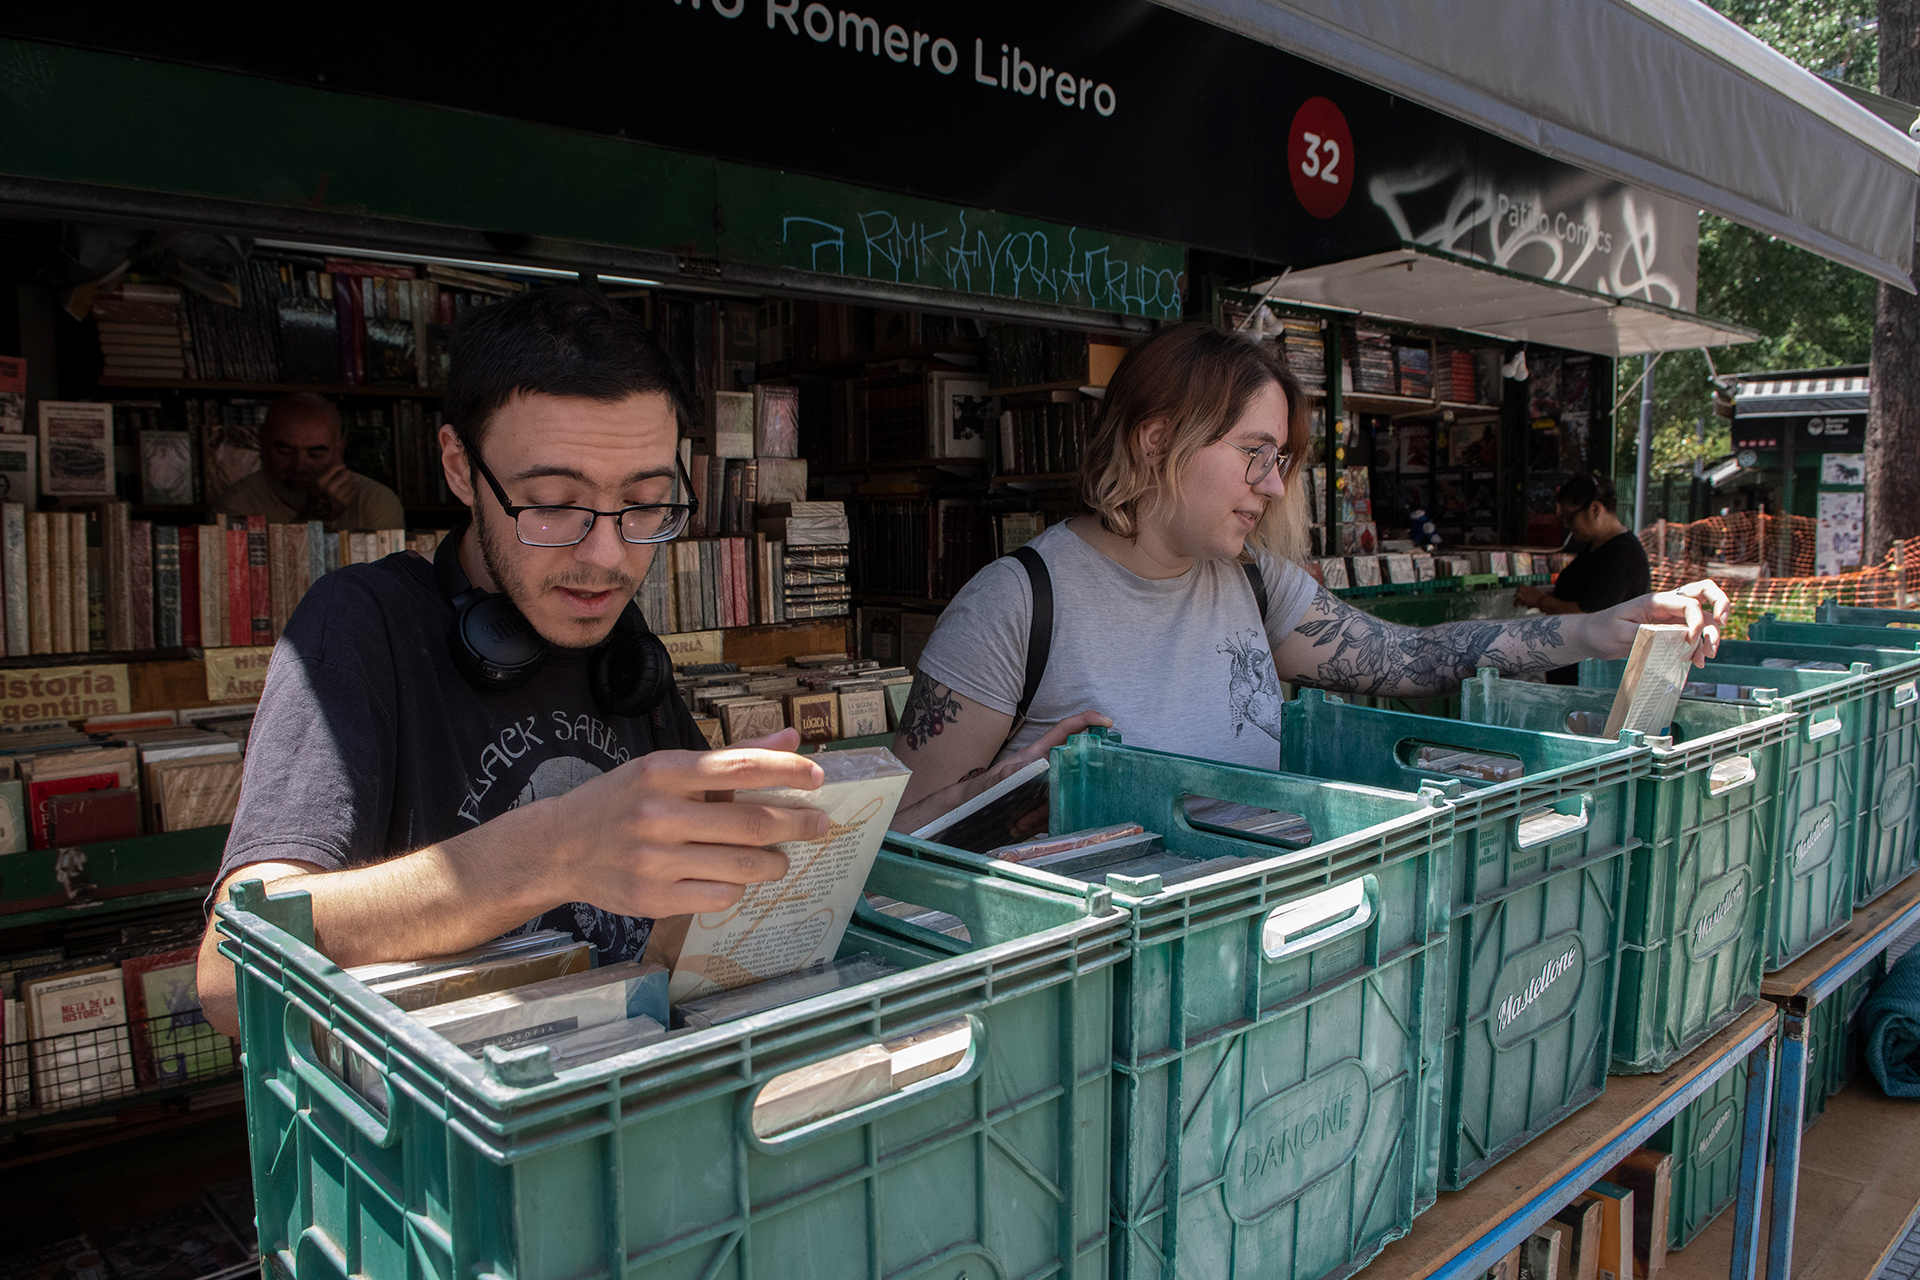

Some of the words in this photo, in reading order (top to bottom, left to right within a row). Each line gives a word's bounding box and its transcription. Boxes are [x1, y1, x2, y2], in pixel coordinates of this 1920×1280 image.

[767, 0, 958, 75] Romero
[975, 37, 1117, 117] Librero
[1301, 131, 1341, 186] 32
[1555, 211, 1612, 254] Comcs
[664, 640, 704, 653] ORIA
[61, 1003, 86, 1014] META
[89, 1000, 101, 1009] DE
[103, 997, 115, 1006] LA
[1496, 943, 1576, 1036] Mastellone
[62, 1008, 105, 1023] HISTORIA
[1243, 1094, 1352, 1185] DANONE
